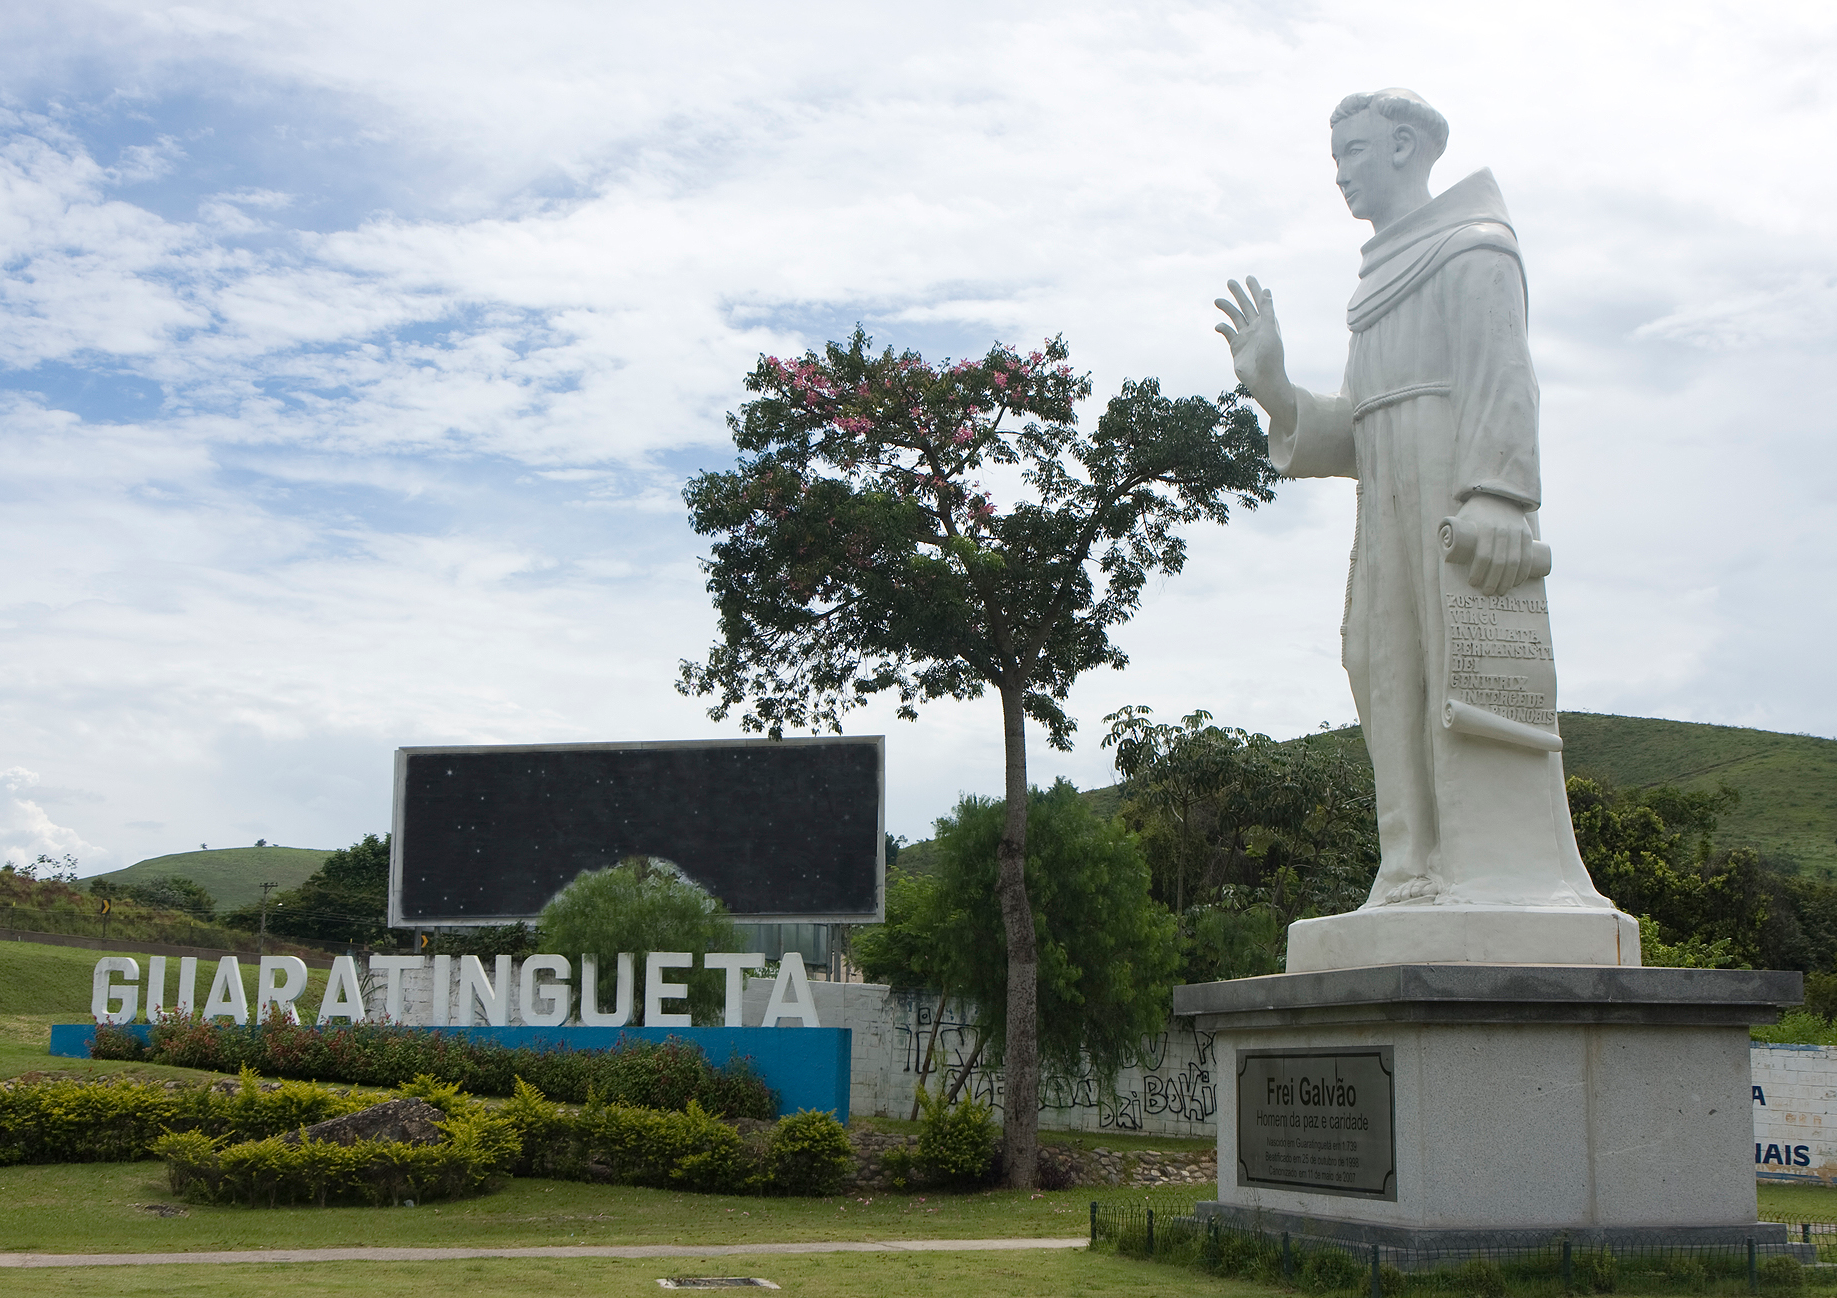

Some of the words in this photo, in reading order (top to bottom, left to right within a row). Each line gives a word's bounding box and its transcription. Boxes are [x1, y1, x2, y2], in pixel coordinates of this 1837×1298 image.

[1489, 596, 1548, 614] PARTUM
[1450, 609, 1498, 625] VIRGO
[1451, 625, 1541, 644] INVIOLATA
[1452, 657, 1479, 673] DEI
[1451, 674, 1528, 692] GENITRIX
[1461, 690, 1544, 708] INTERCEDE
[91, 952, 820, 1028] GUARATINGUETA
[1267, 1077, 1294, 1105] Frei
[1299, 1077, 1356, 1107] Galvão
[1257, 1110, 1287, 1127] Homem
[1290, 1111, 1300, 1127] da
[1303, 1115, 1319, 1132] paz
[1321, 1116, 1327, 1129] e
[1330, 1113, 1369, 1130] caridade
[1266, 1137, 1287, 1148] Nascido
[1287, 1140, 1295, 1148] em
[1333, 1142, 1342, 1150] em
[1342, 1141, 1357, 1151] 1.739
[1265, 1151, 1292, 1163] Beatificado
[1293, 1155, 1301, 1163] em
[1302, 1154, 1309, 1164] 25
[1310, 1155, 1317, 1165] de
[1318, 1156, 1337, 1167] outubro
[1338, 1157, 1345, 1167] de
[1269, 1165, 1297, 1178] Canonizado
[1299, 1170, 1307, 1178] em
[1308, 1169, 1313, 1179] 11
[1314, 1170, 1321, 1179] de
[1322, 1170, 1334, 1181] maio
[1336, 1172, 1342, 1182] de
[1343, 1171, 1356, 1183] 2007
